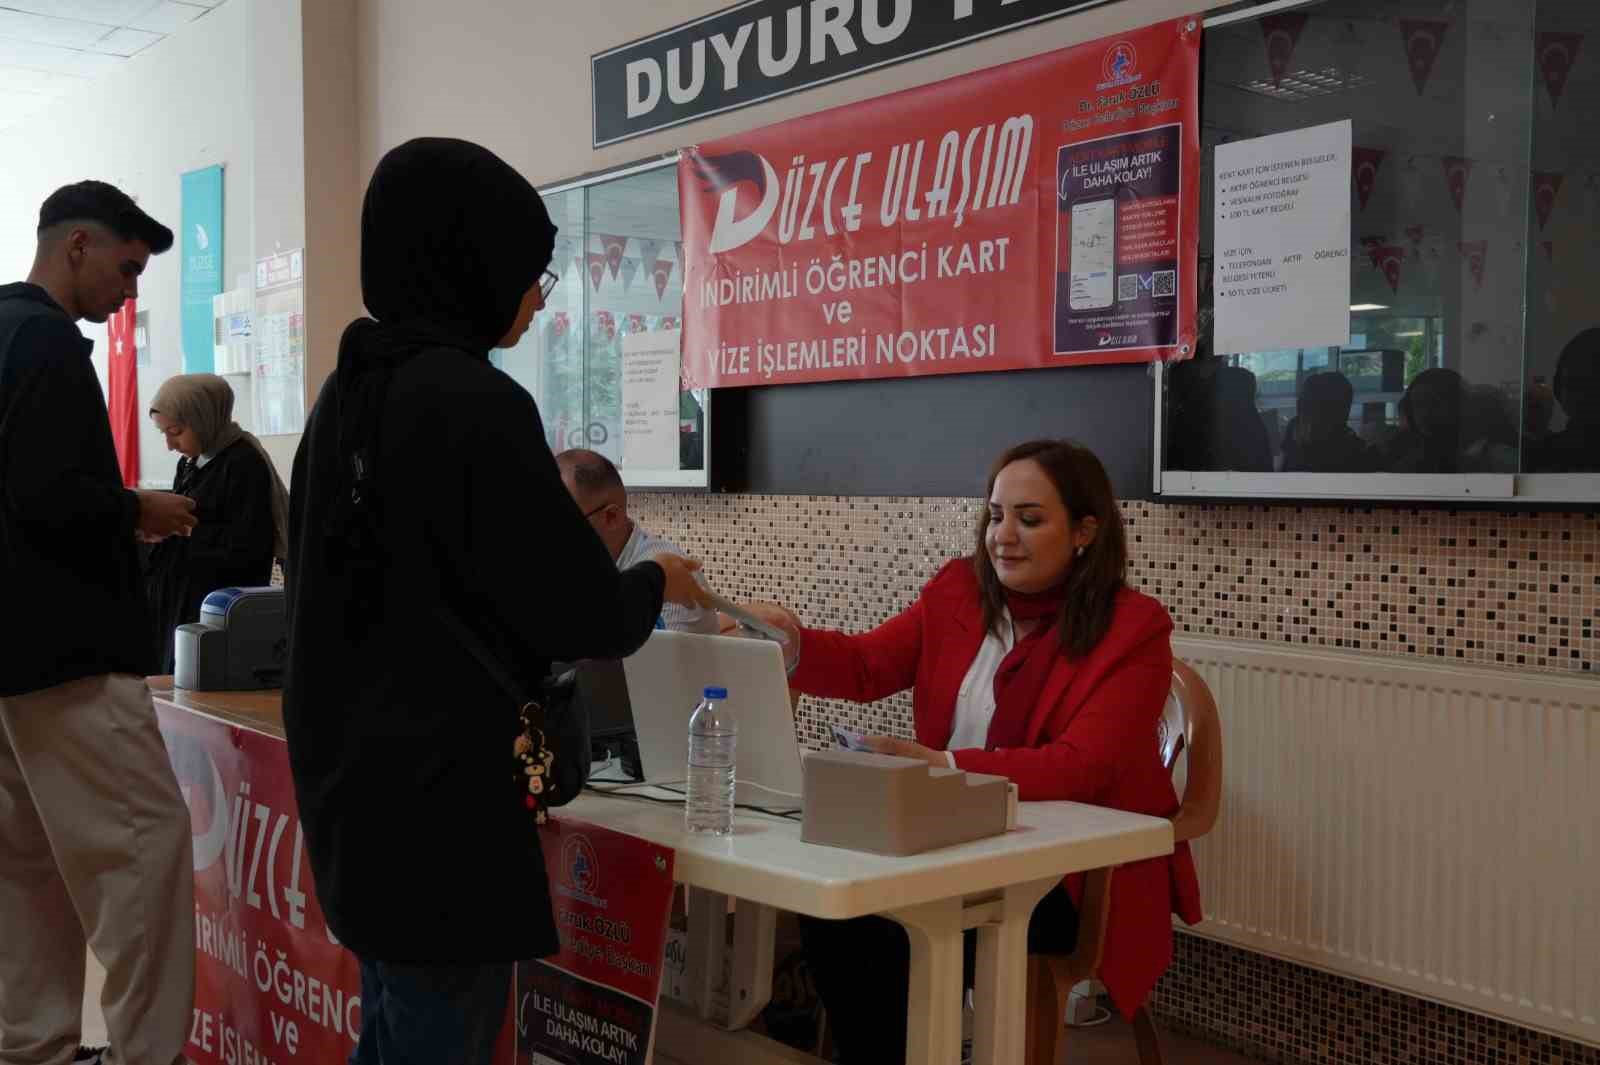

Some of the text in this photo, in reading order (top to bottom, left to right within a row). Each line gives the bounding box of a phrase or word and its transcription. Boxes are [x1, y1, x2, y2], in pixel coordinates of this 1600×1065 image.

[626, 0, 912, 119] DUYURU
[880, 114, 1034, 229] ULAŞIM
[1083, 167, 1152, 189] DAHA KOLAY!
[1130, 151, 1161, 167] ARTIK
[805, 242, 928, 295] ÖĞRENCİ
[937, 238, 1010, 279] KART
[822, 300, 852, 324] ve
[708, 323, 995, 378] VİZE İŞLEMLERİ NOKTASI
[194, 901, 248, 980] İRİMLİ
[253, 939, 362, 1044] ÖĞRENC
[270, 1010, 299, 1055] ve
[546, 1020, 580, 1048] DAHA
[600, 1021, 638, 1051] ARTIK
